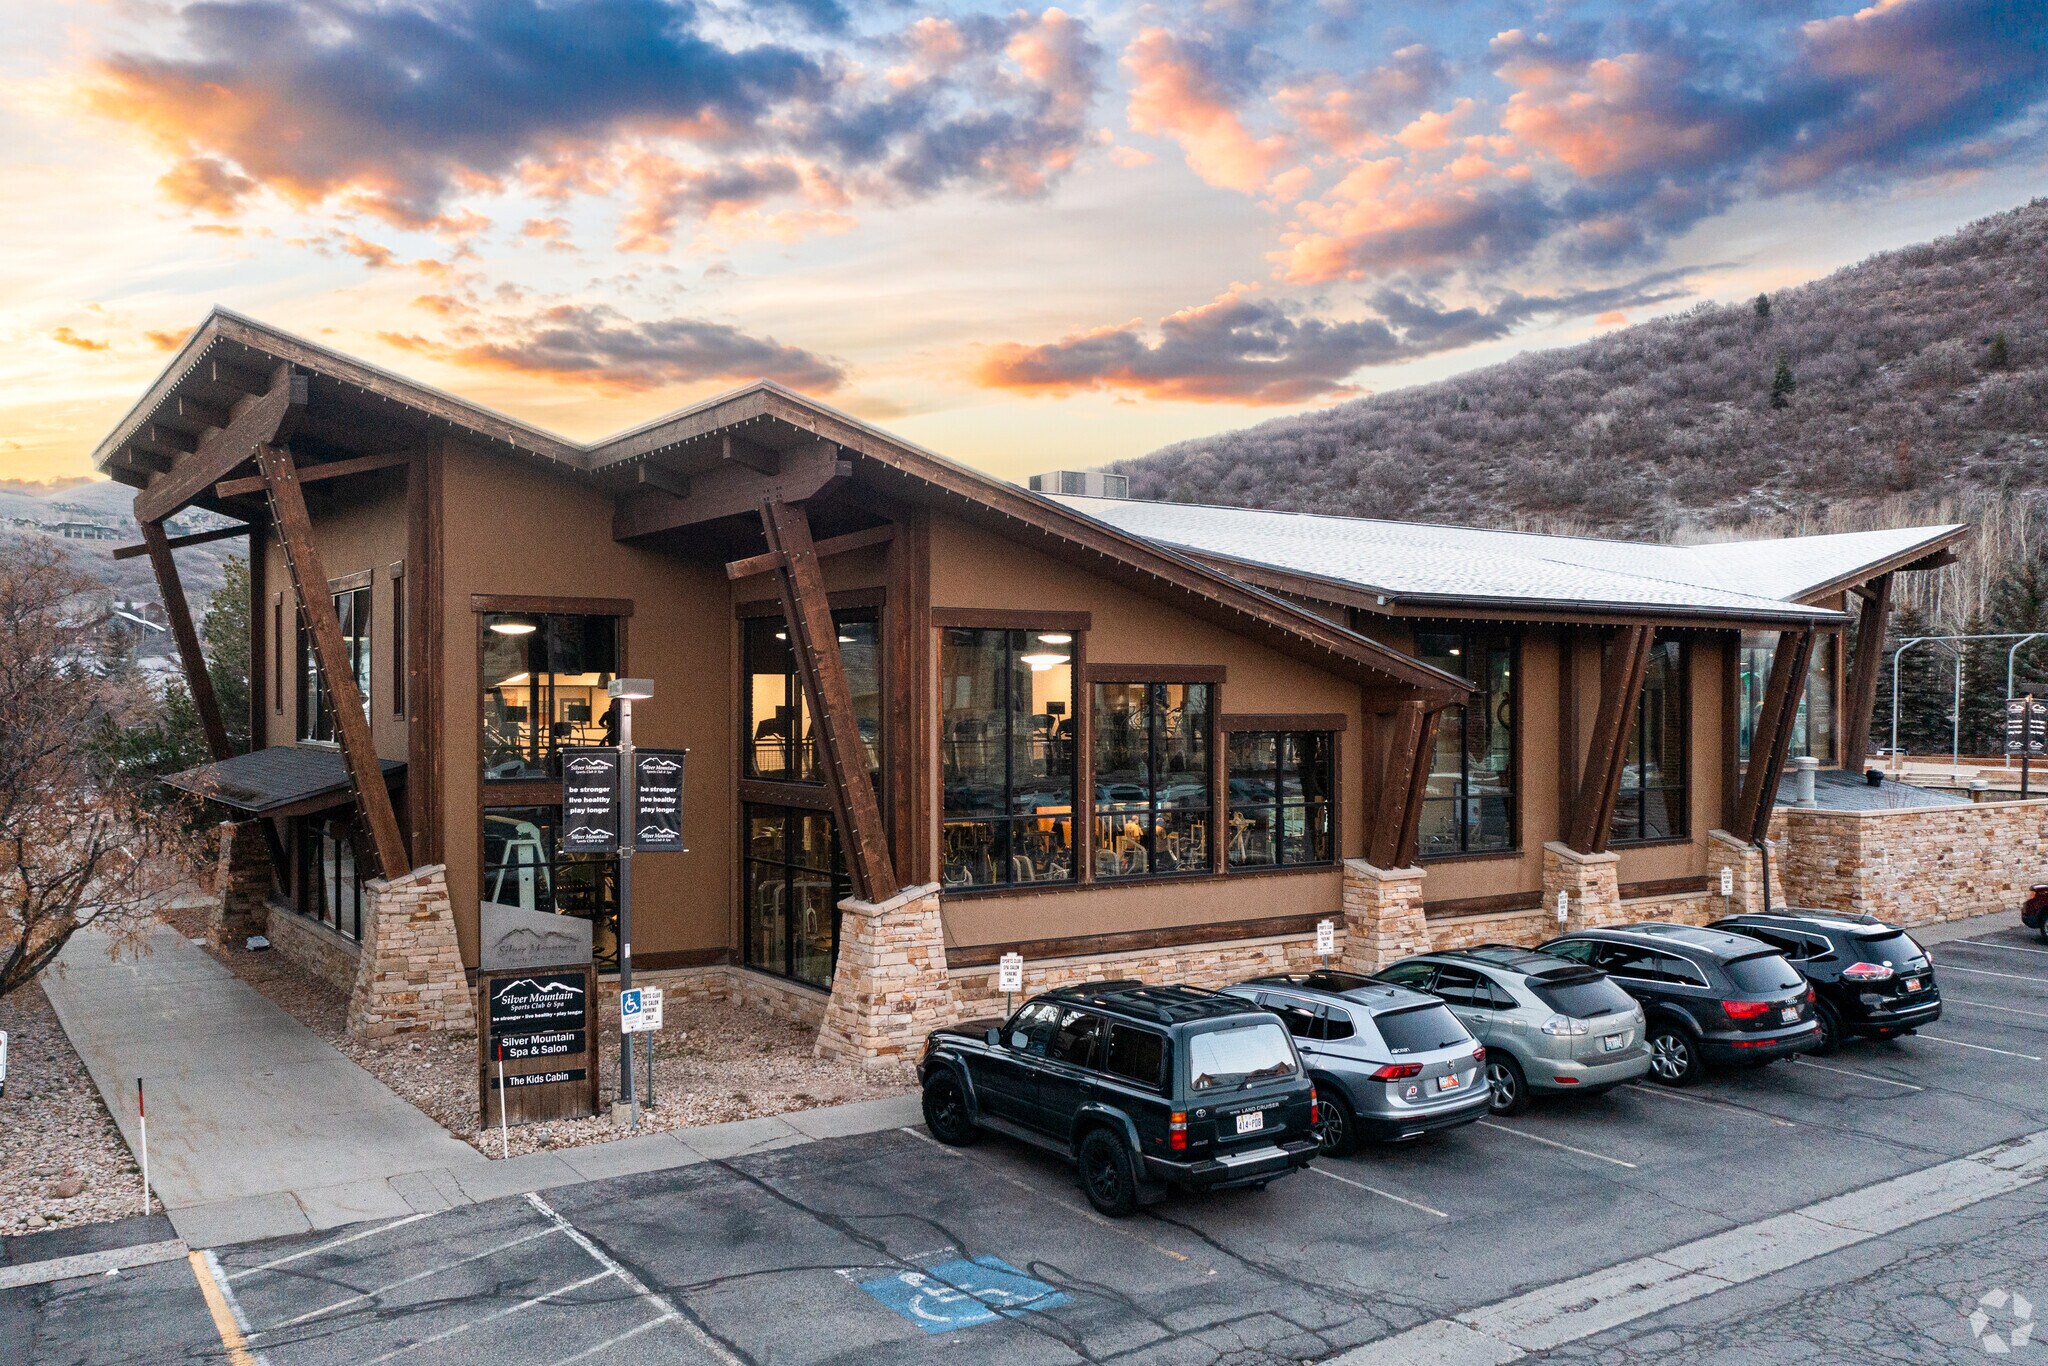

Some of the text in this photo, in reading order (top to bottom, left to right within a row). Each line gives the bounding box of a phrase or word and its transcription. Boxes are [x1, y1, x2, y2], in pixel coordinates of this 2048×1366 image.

[653, 796, 676, 804] healthy
[501, 991, 573, 1005] Silver Mountain
[511, 1003, 530, 1012] Sports
[553, 1001, 565, 1009] Spa
[501, 1013, 521, 1021] stronger
[502, 1033, 575, 1047] Silver Mountain
[509, 1044, 568, 1058] Spa & Salon
[509, 1072, 569, 1086] The Kids Cabin
[1257, 1102, 1279, 1110] CRUISER
